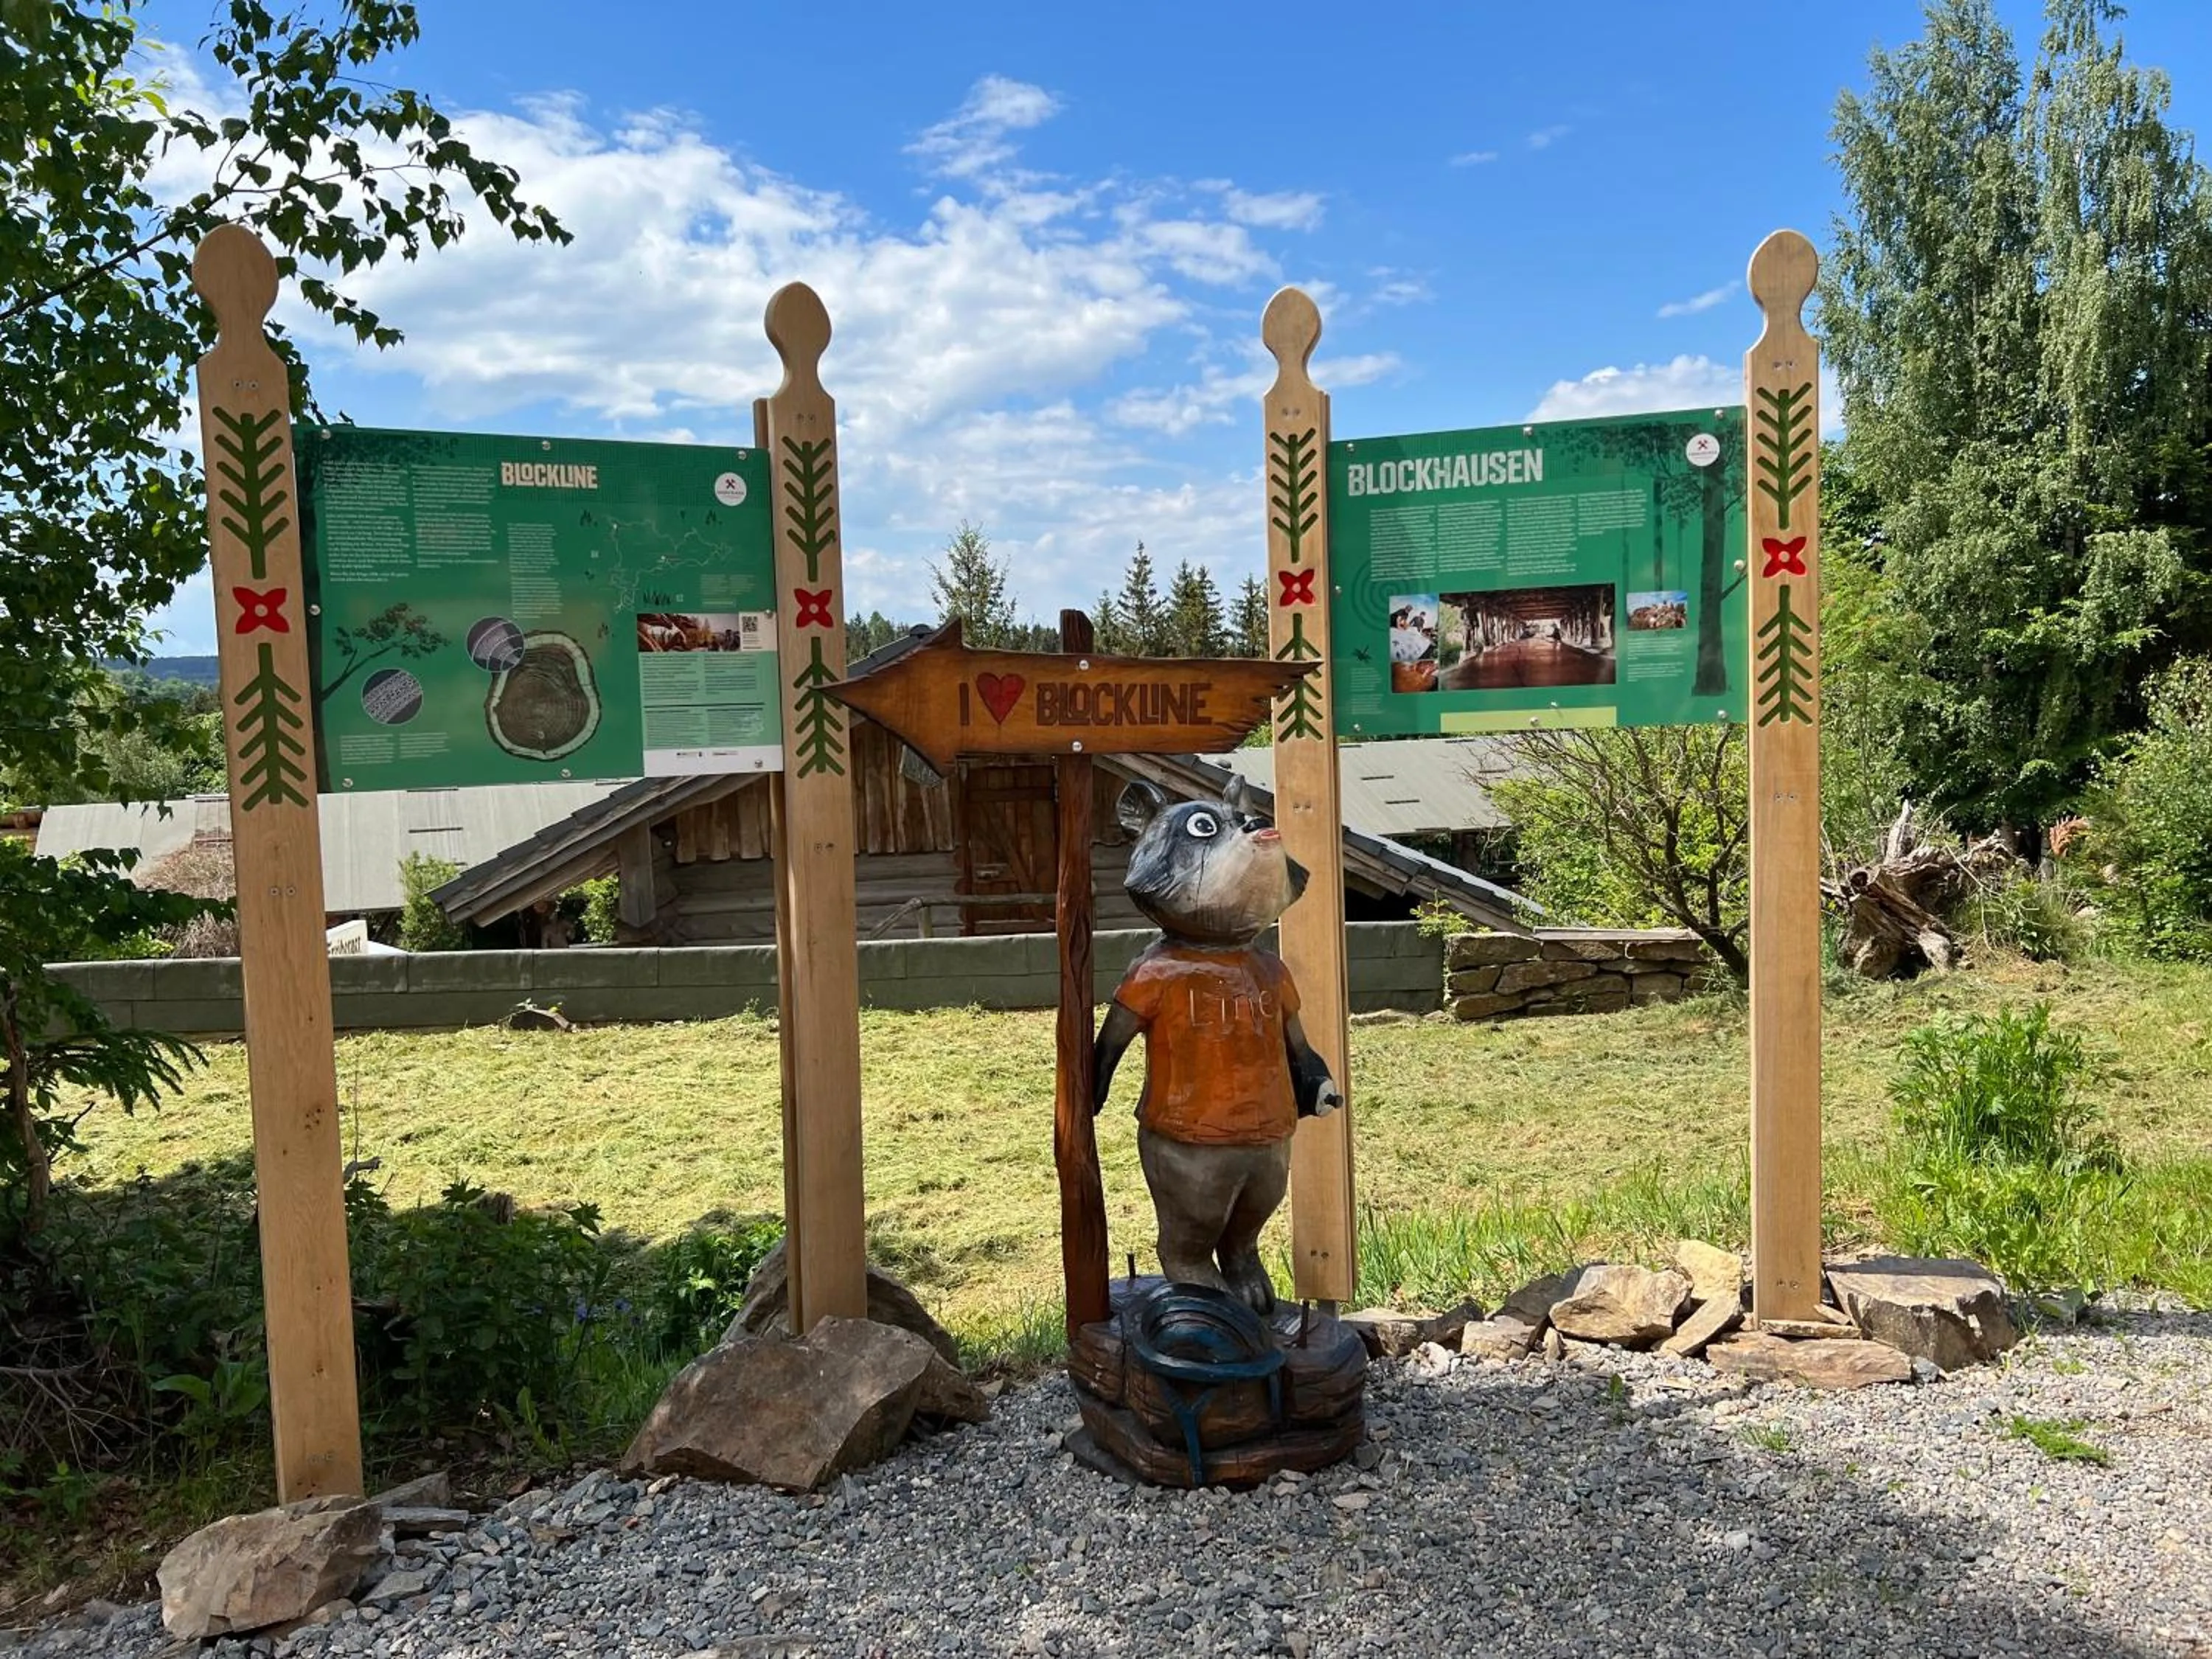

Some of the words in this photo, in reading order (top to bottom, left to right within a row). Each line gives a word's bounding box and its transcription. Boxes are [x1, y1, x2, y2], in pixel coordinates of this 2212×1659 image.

[501, 461, 598, 490] BLOCKLINE
[1348, 448, 1543, 496] BLOCKHAUSEN
[959, 682, 970, 726] I
[1036, 682, 1214, 727] BLOCKLINE
[1189, 979, 1274, 1027] Line
